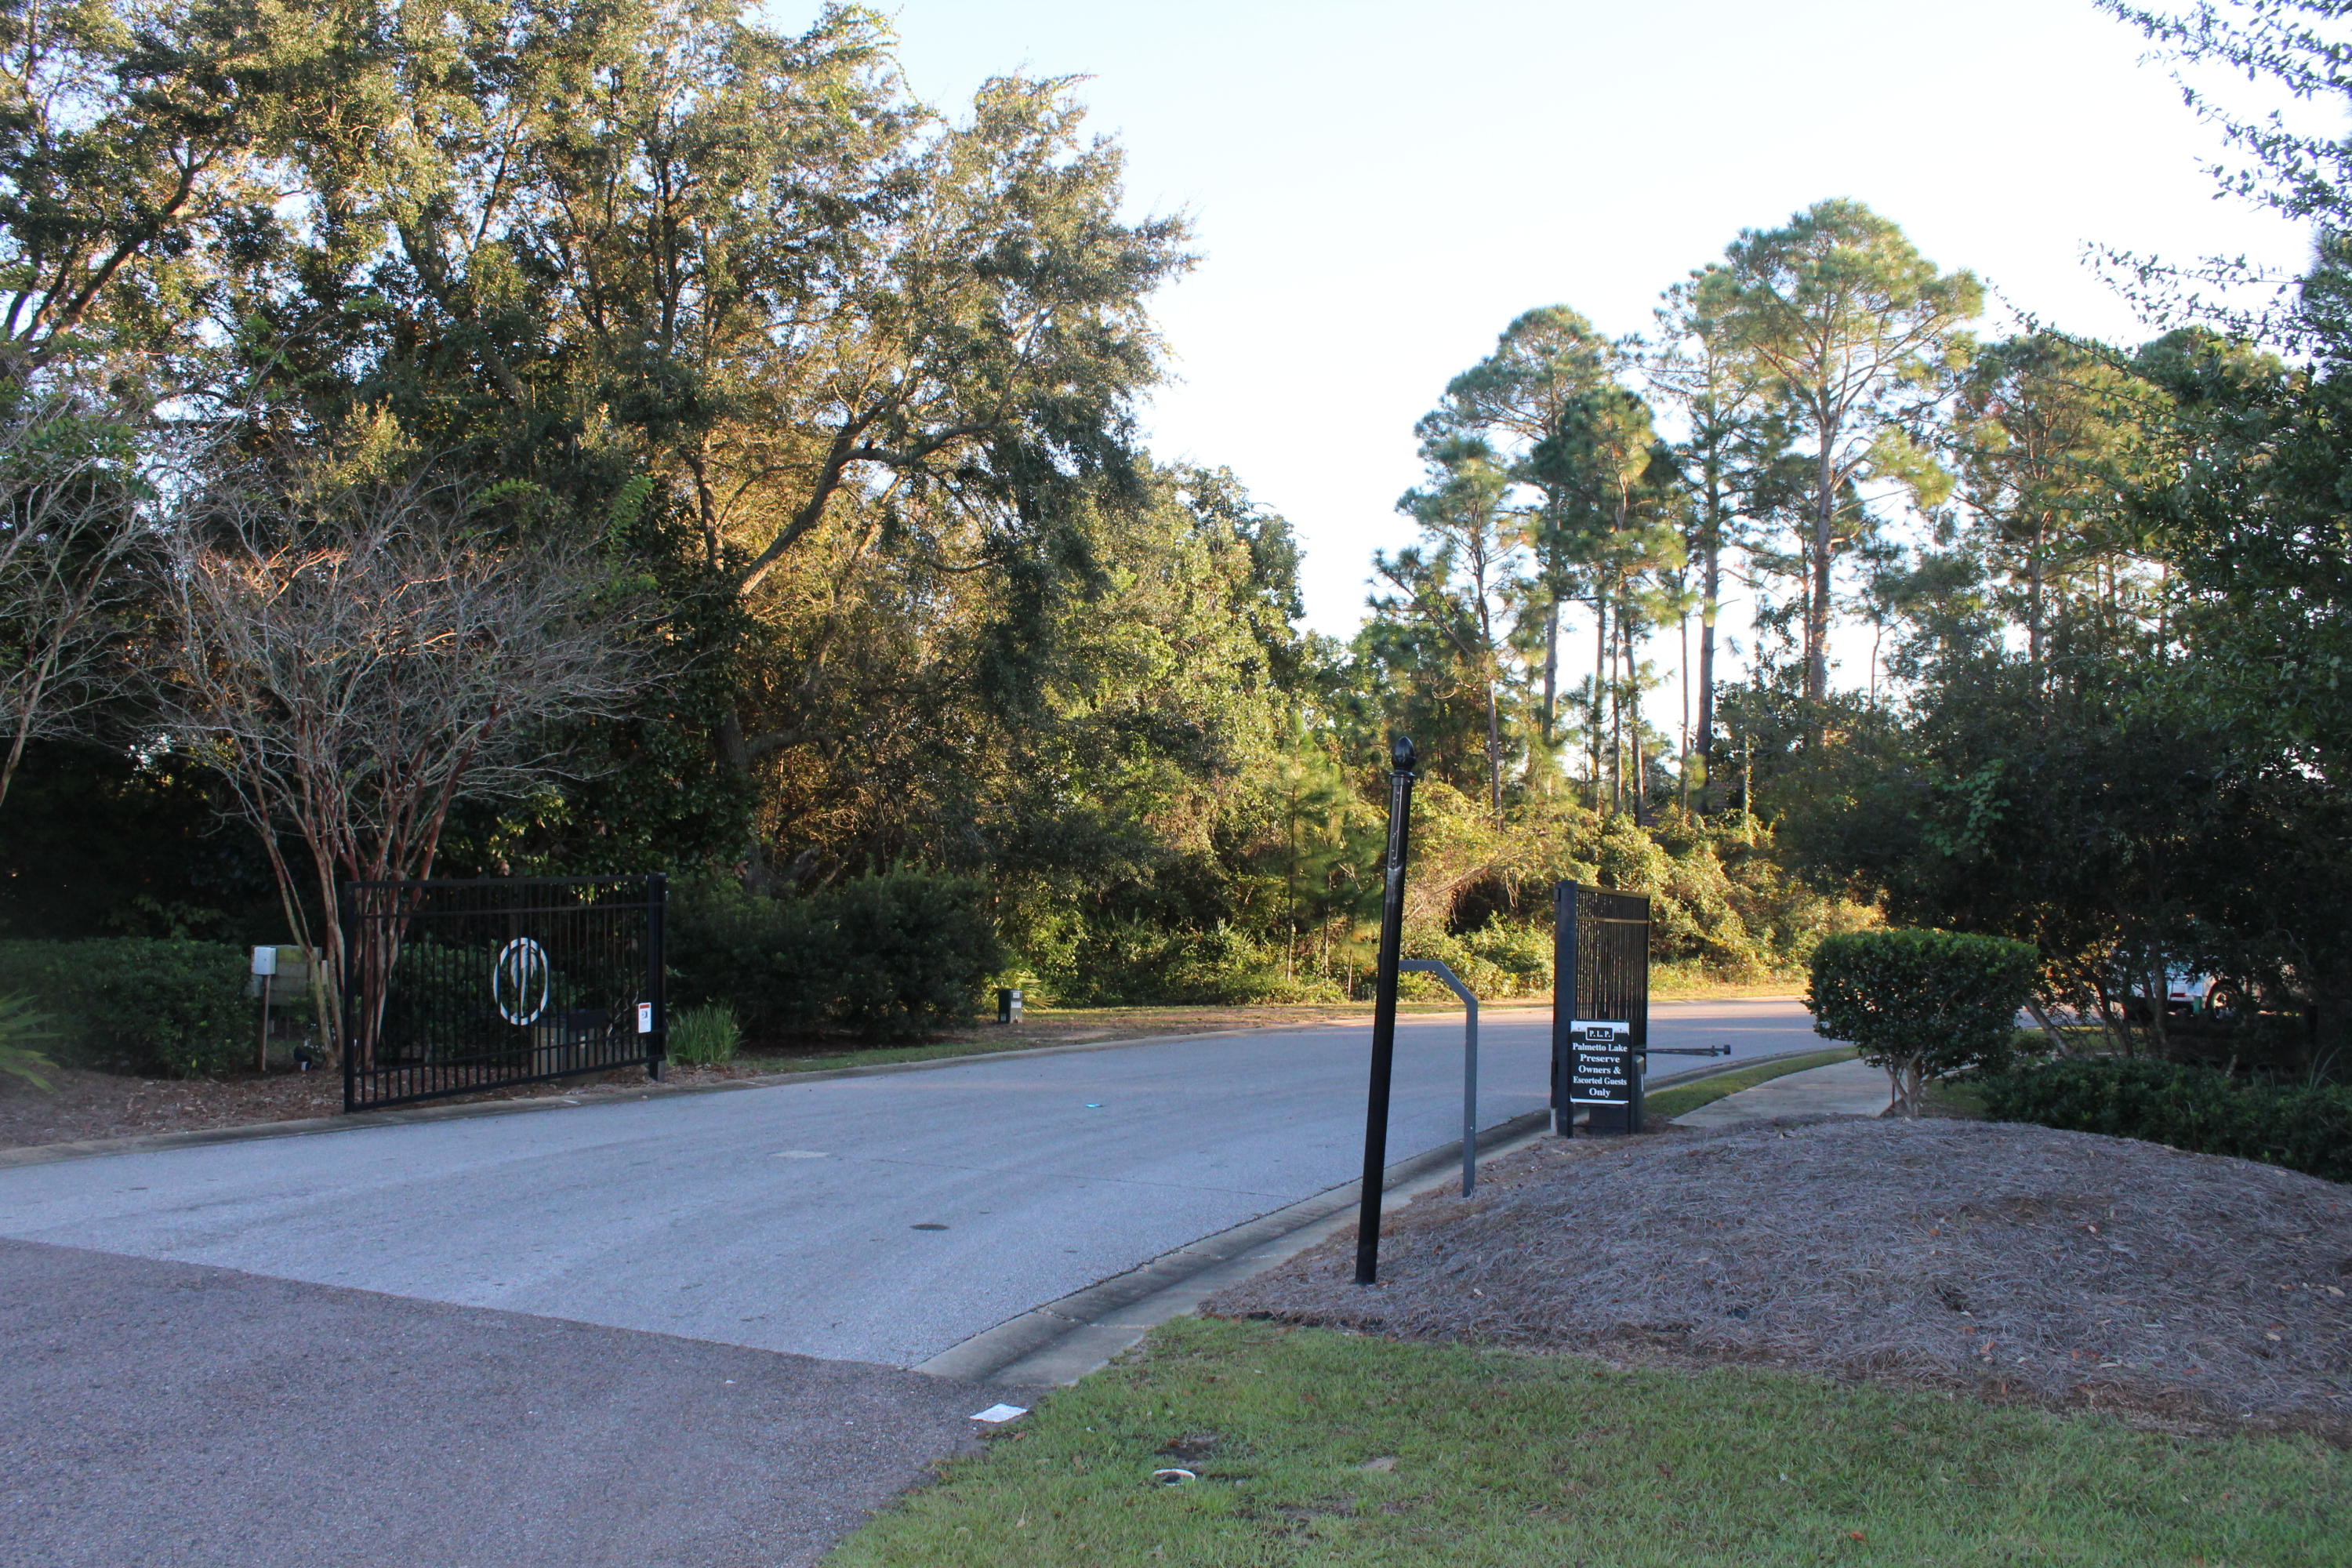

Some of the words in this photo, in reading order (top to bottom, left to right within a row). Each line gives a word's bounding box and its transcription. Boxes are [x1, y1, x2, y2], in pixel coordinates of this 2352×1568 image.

[1580, 1054, 1620, 1063] Preserve
[1578, 1065, 1610, 1074] Owners
[1573, 1076, 1602, 1084] Escorted
[1589, 1088, 1610, 1098] Only
